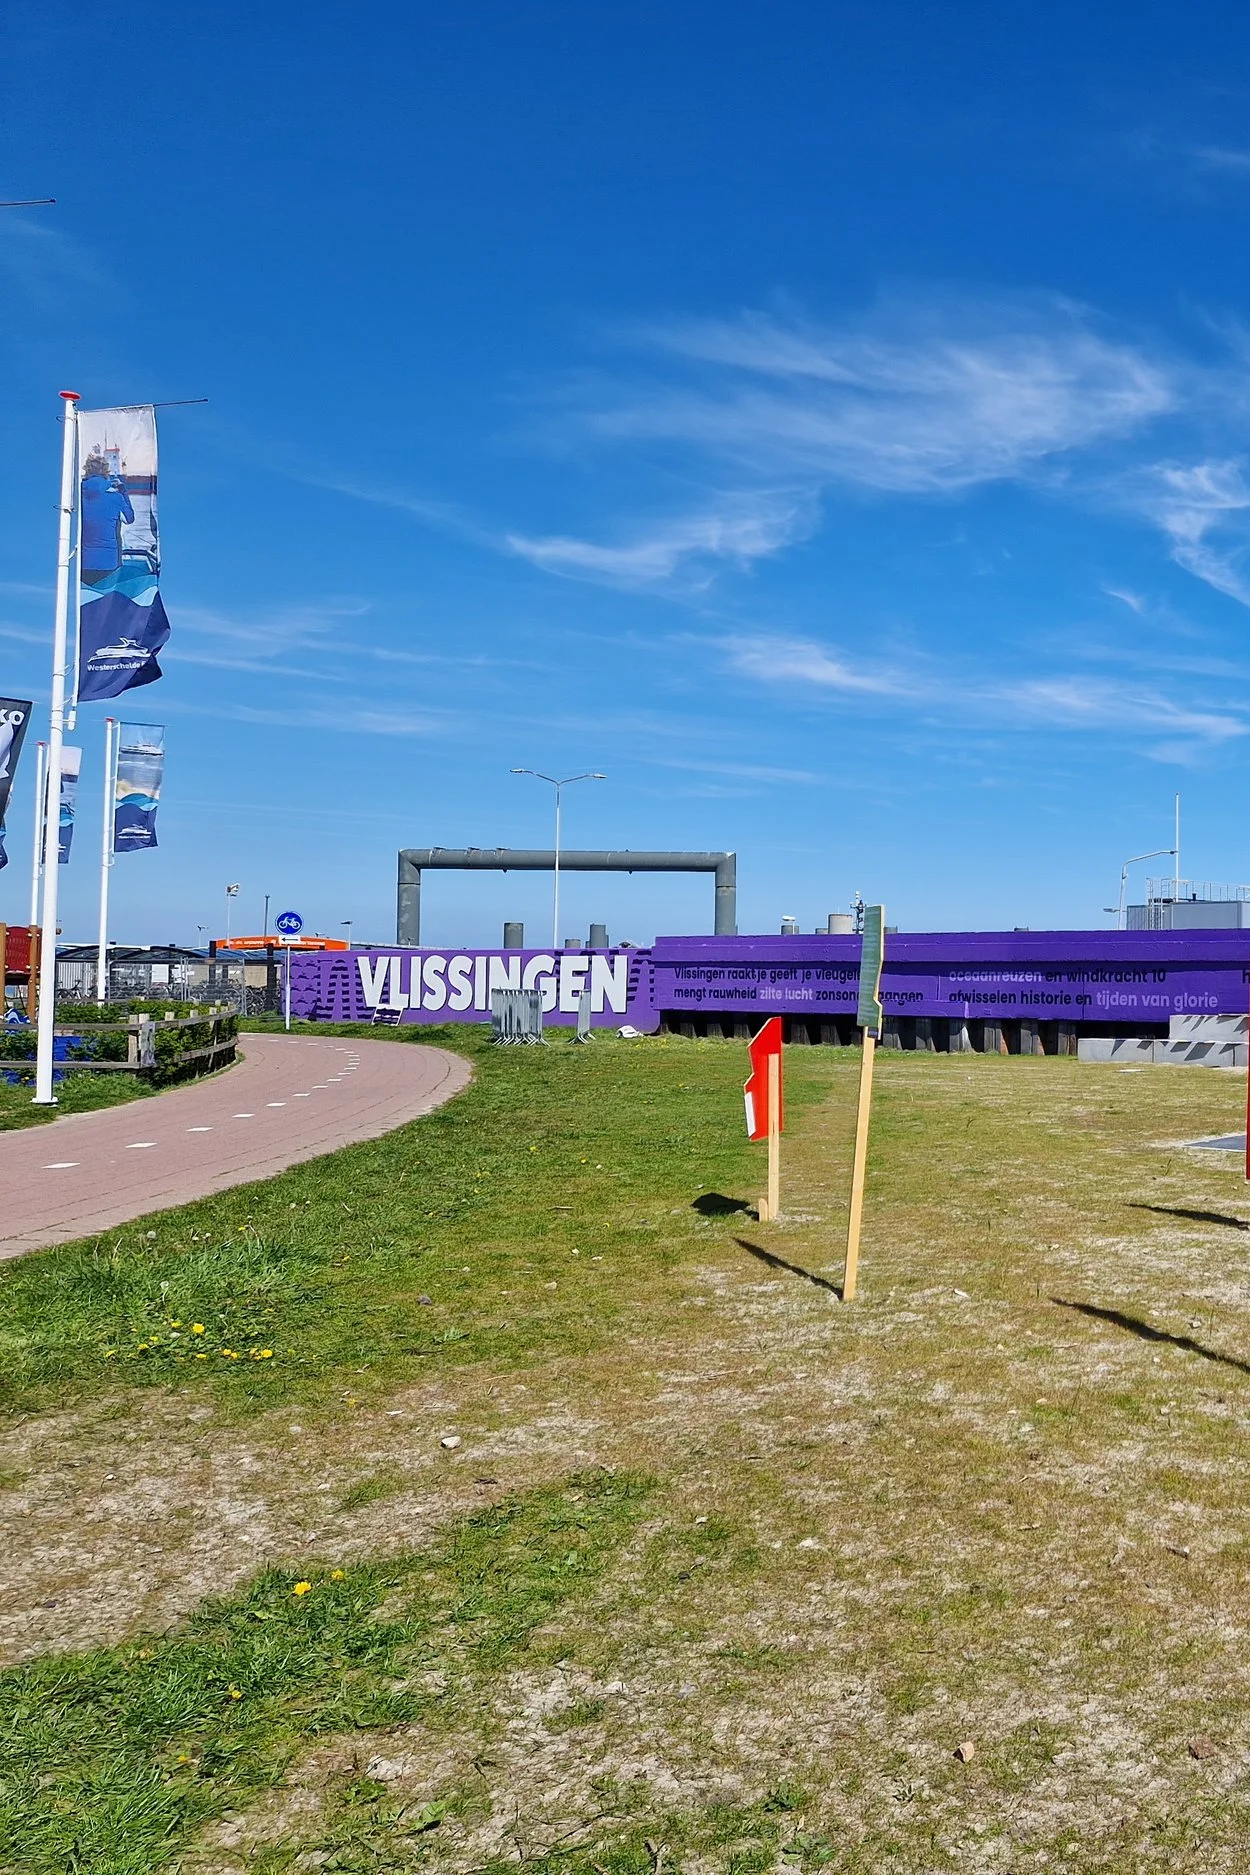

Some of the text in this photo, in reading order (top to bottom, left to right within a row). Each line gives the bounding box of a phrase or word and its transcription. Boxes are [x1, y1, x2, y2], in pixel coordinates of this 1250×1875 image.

[87, 662, 140, 671] Westerschelde
[357, 954, 628, 1012] VLISSINGEN
[674, 967, 725, 983] Vlissingen
[757, 969, 766, 983] je
[770, 968, 798, 984] geeft
[801, 969, 812, 984] je
[949, 968, 1166, 984] oceaanreuzen en windkracht 10
[674, 987, 706, 1002] mengt
[708, 987, 756, 1000] rauwheid
[760, 987, 782, 1000] zilte
[786, 988, 813, 1000] lucht
[949, 989, 1218, 1012] afwisselen historie en tijden van glorie
